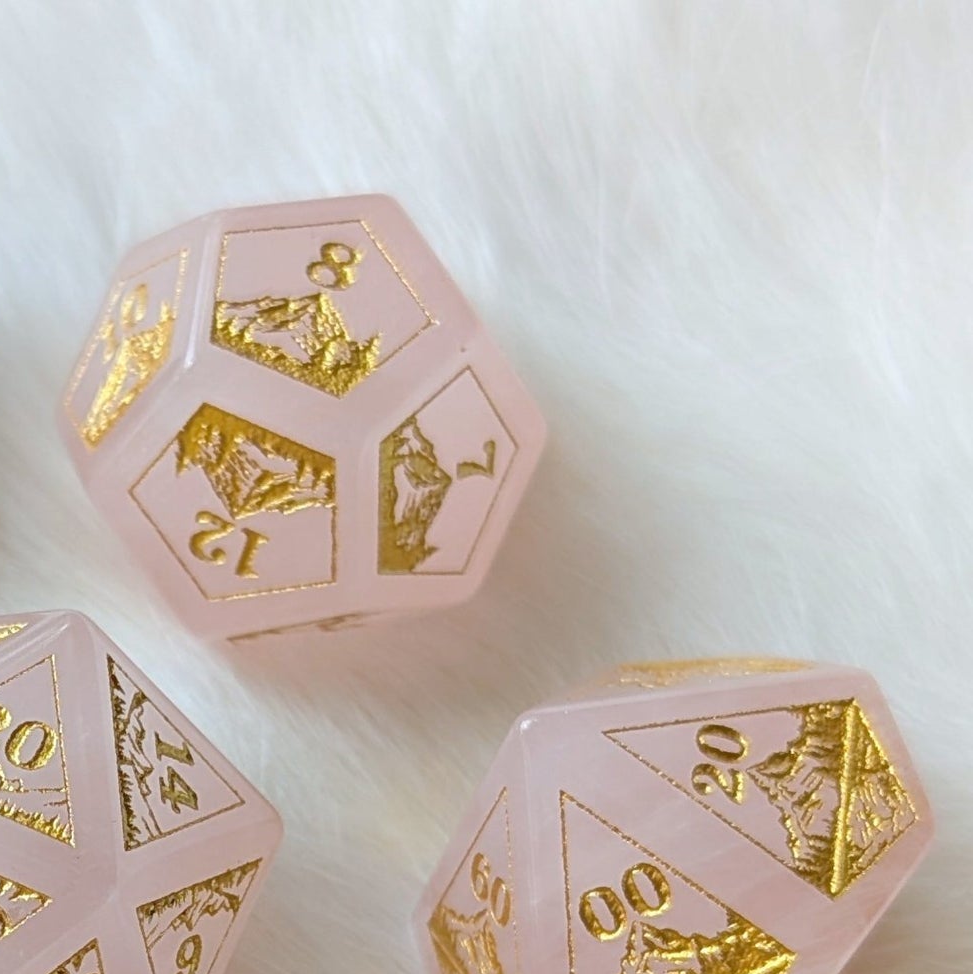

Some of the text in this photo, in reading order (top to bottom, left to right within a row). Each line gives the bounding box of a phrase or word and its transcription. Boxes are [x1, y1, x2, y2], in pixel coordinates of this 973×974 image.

[306, 242, 364, 291] 8
[456, 440, 495, 479] 7
[189, 510, 269, 579] 12
[155, 731, 199, 814] 14
[691, 724, 748, 805] 20
[470, 852, 512, 927] 60
[578, 862, 670, 942] 00
